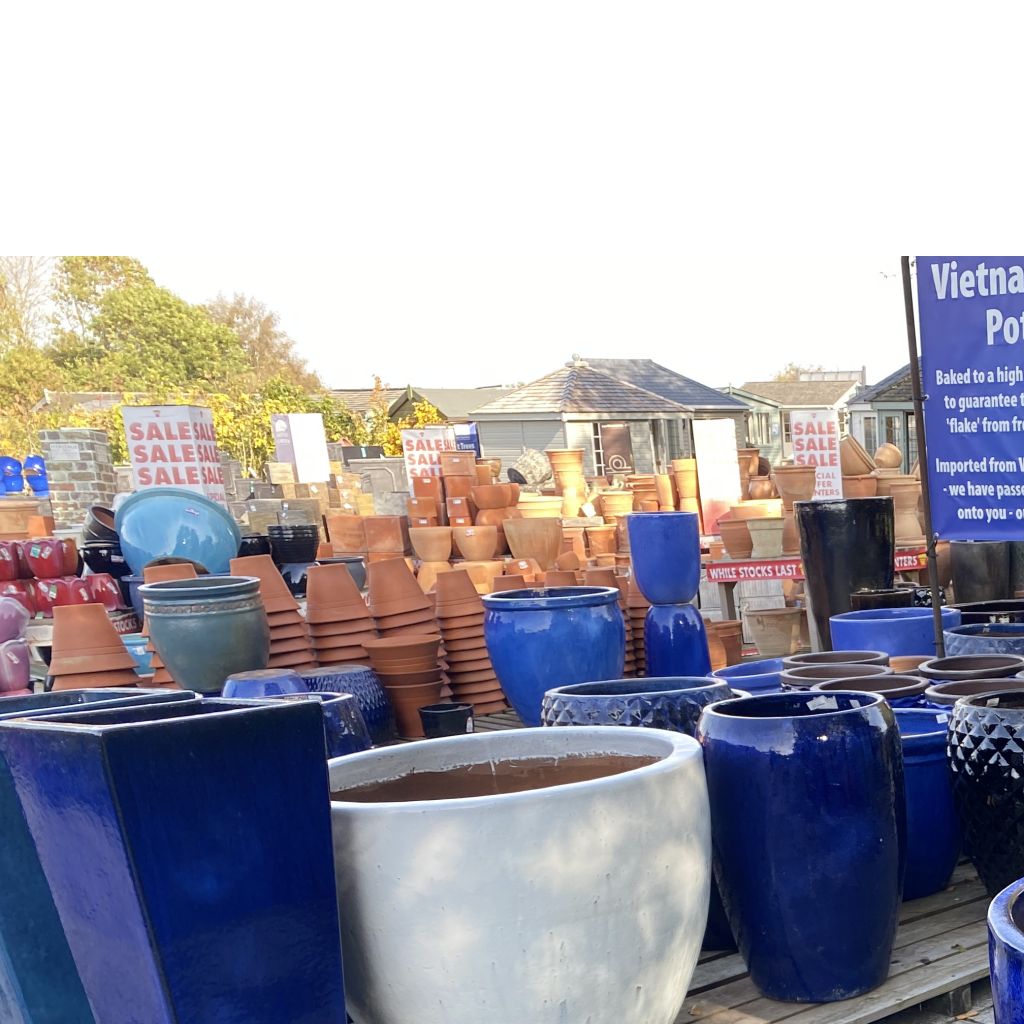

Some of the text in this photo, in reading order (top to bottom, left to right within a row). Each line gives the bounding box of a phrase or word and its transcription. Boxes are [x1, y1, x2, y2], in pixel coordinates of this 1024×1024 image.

[936, 369, 970, 385] Baked
[973, 370, 986, 384] to
[987, 372, 994, 383] a
[996, 366, 1023, 386] high
[944, 396, 956, 409] to
[958, 392, 1017, 412] guarantee
[129, 421, 193, 441] SALE
[794, 420, 836, 435] SALE
[946, 417, 980, 433] 'flake'
[982, 417, 1010, 433] from
[405, 438, 444, 452] SALE
[795, 437, 837, 451] SALE
[133, 444, 196, 463] SALE
[795, 453, 838, 467] SALE
[935, 458, 987, 476] Imported
[989, 457, 1016, 473] from
[137, 466, 200, 485] SALE
[816, 472, 836, 480] CIAL
[949, 485, 966, 497] we
[967, 481, 995, 497] have
[957, 506, 984, 520] onto
[986, 509, 1007, 524] you
[895, 556, 918, 567] NTERS
[709, 564, 797, 579] WHILE STOCKS LAST
